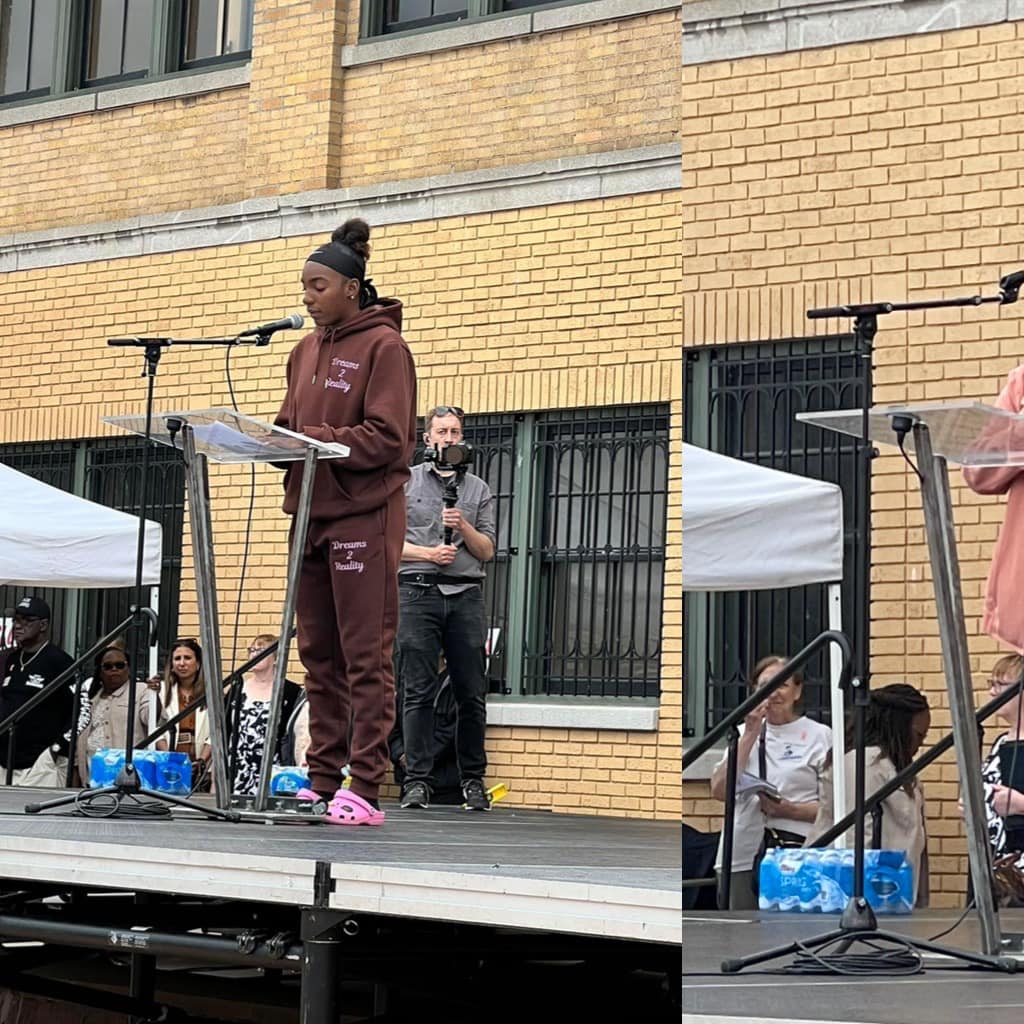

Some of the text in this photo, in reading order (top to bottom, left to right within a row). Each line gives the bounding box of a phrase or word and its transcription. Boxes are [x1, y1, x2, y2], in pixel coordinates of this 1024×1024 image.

[332, 357, 360, 370] Dreams
[338, 368, 346, 378] 2
[331, 540, 367, 550] Dreams
[346, 550, 353, 560] 2
[334, 560, 364, 573] Reality
